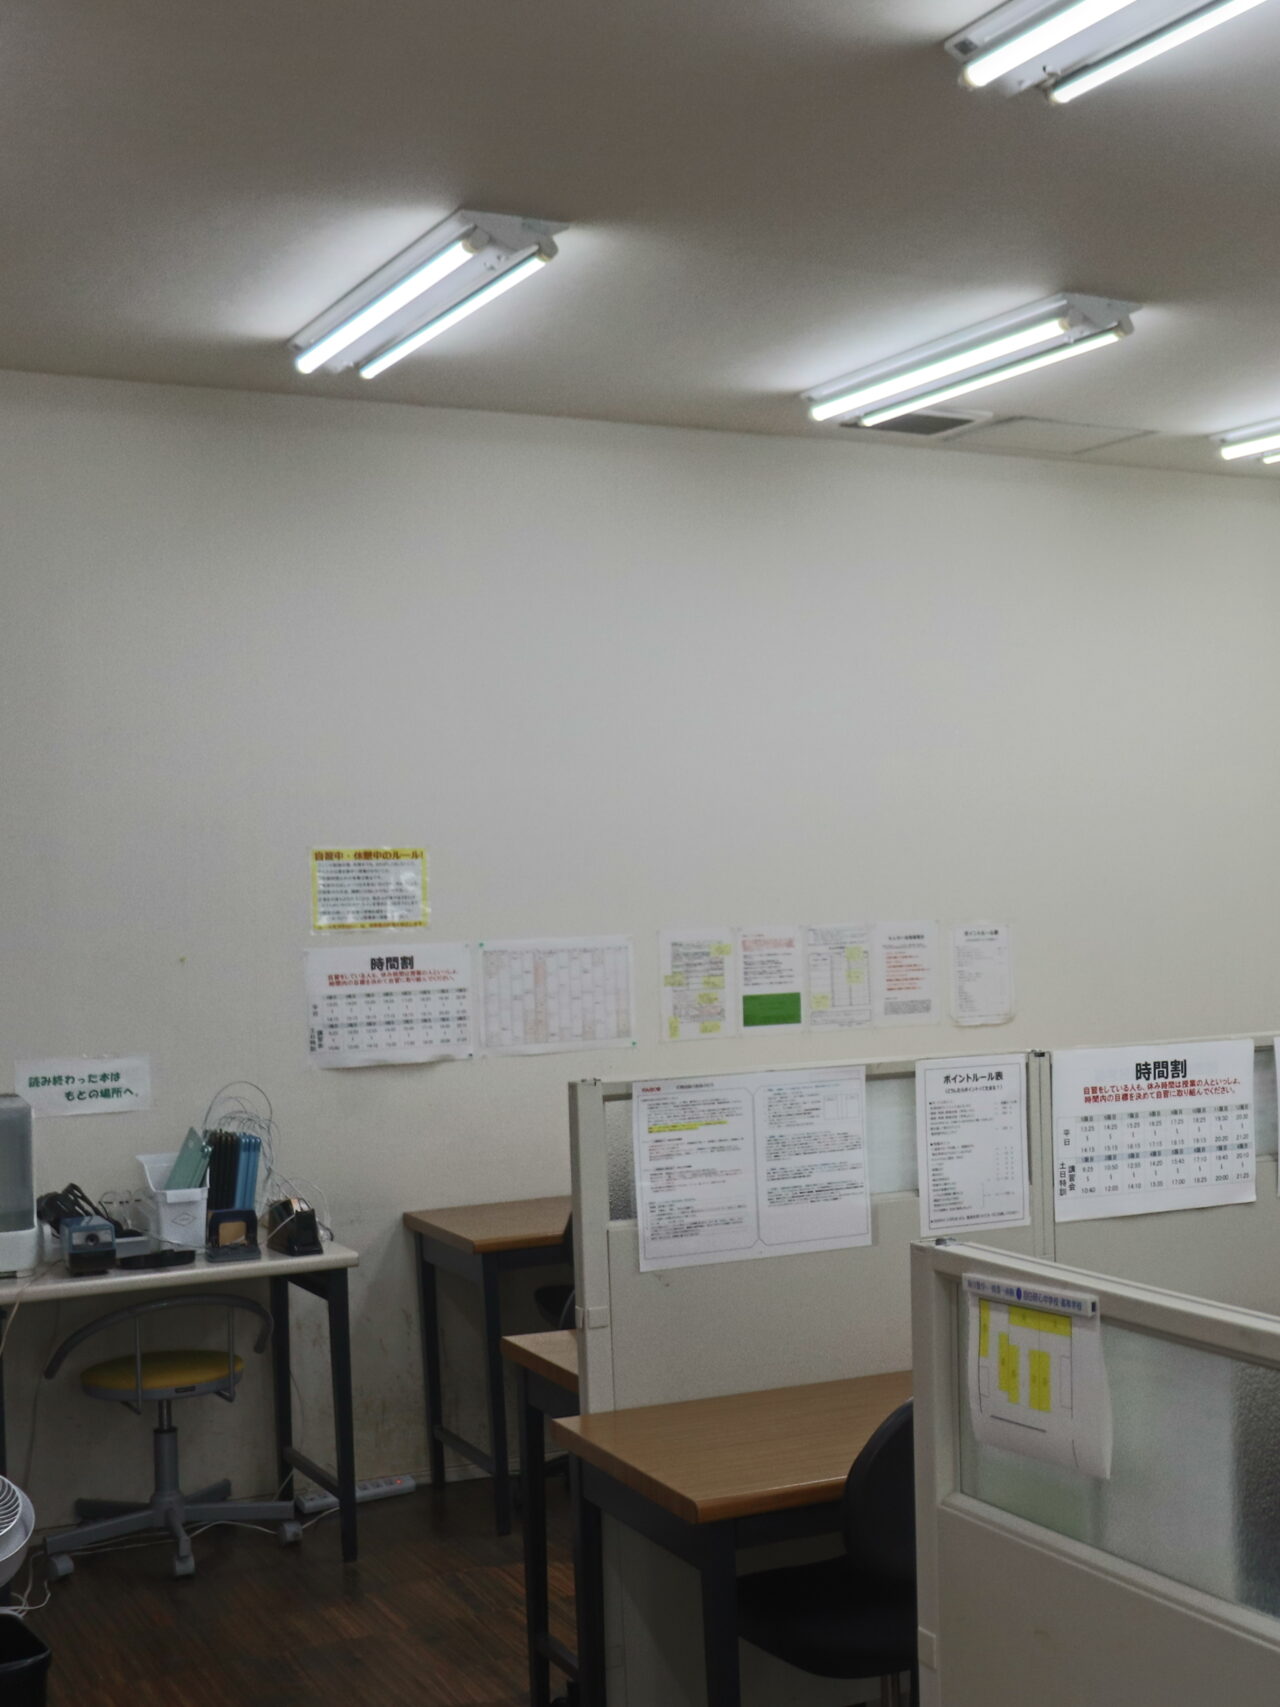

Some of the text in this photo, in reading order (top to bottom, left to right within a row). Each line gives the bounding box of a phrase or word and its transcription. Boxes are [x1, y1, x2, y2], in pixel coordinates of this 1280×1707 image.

[371, 955, 414, 971] 時間割
[944, 1071, 1003, 1084] ポイントルール表
[1135, 1059, 1187, 1081] 時間割
[28, 1072, 120, 1088] 読み終わった本は
[65, 1087, 139, 1101] もとの場所へ。
